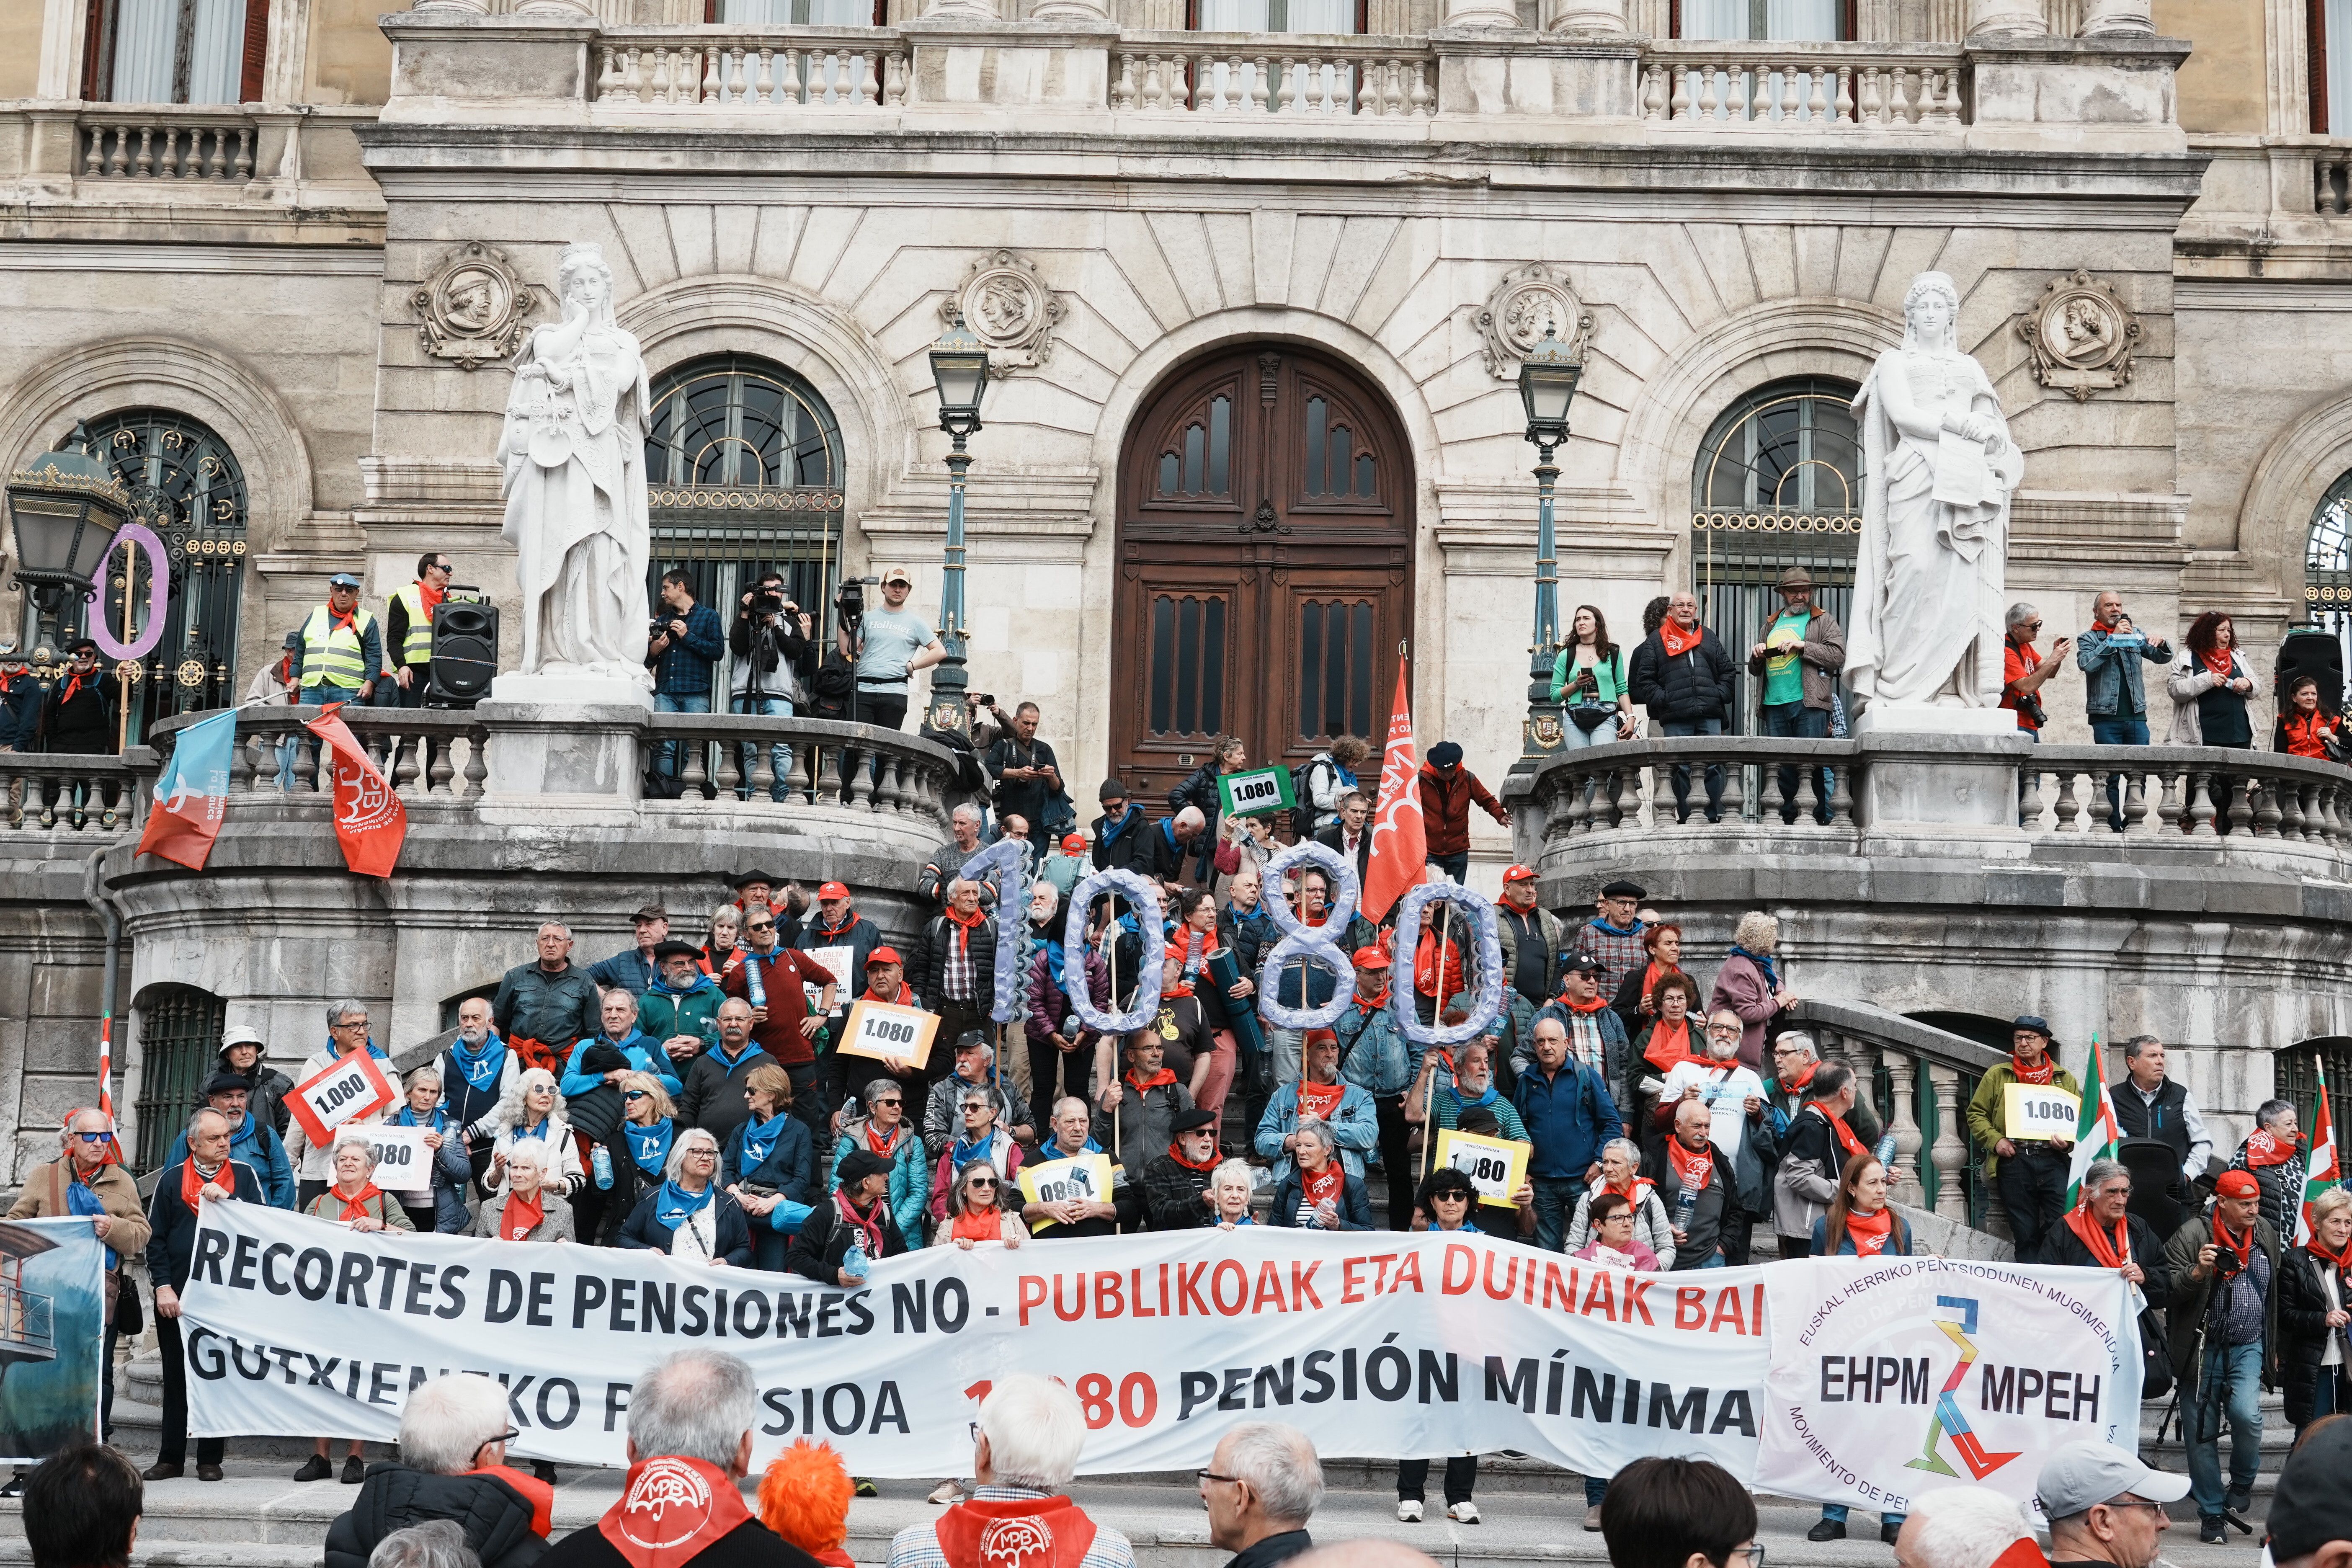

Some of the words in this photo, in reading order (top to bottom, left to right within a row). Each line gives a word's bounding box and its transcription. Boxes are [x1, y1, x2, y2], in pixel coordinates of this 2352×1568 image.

[869, 621, 911, 635] Hollister
[1234, 781, 1275, 802] 1.080
[866, 1019, 914, 1043] 1.080
[315, 1074, 365, 1114] 1.080
[317, 1077, 332, 1088] PENSIÓN
[2024, 1101, 2075, 1122] 1.080
[376, 1143, 411, 1166] 080
[191, 1228, 470, 1320] RECORTES
[484, 1269, 555, 1327] DE
[572, 1274, 874, 1339] PENSIONES
[892, 1277, 969, 1333] NO
[1019, 1259, 1323, 1327] PUBLIKOAK
[1341, 1251, 1423, 1304] ETA
[1442, 1244, 1656, 1326] DUINAK
[1675, 1283, 1764, 1336] BAI
[1800, 1295, 1844, 1346] EUSKAL
[1843, 1264, 1911, 1298] HERRIKO
[1916, 1260, 2044, 1294] PENTSIODUNEN
[1176, 1333, 1458, 1421] PENSIÓN
[1485, 1349, 1756, 1437] MÍNIMA
[1821, 1356, 1929, 1404] EHPM
[1981, 1364, 2100, 1423] MPEH
[1790, 1407, 1855, 1485] MOVIMIENTO
[1858, 1480, 1880, 1500] DE
[648, 1479, 684, 1499] MPB
[1001, 1529, 1032, 1549] MPB
